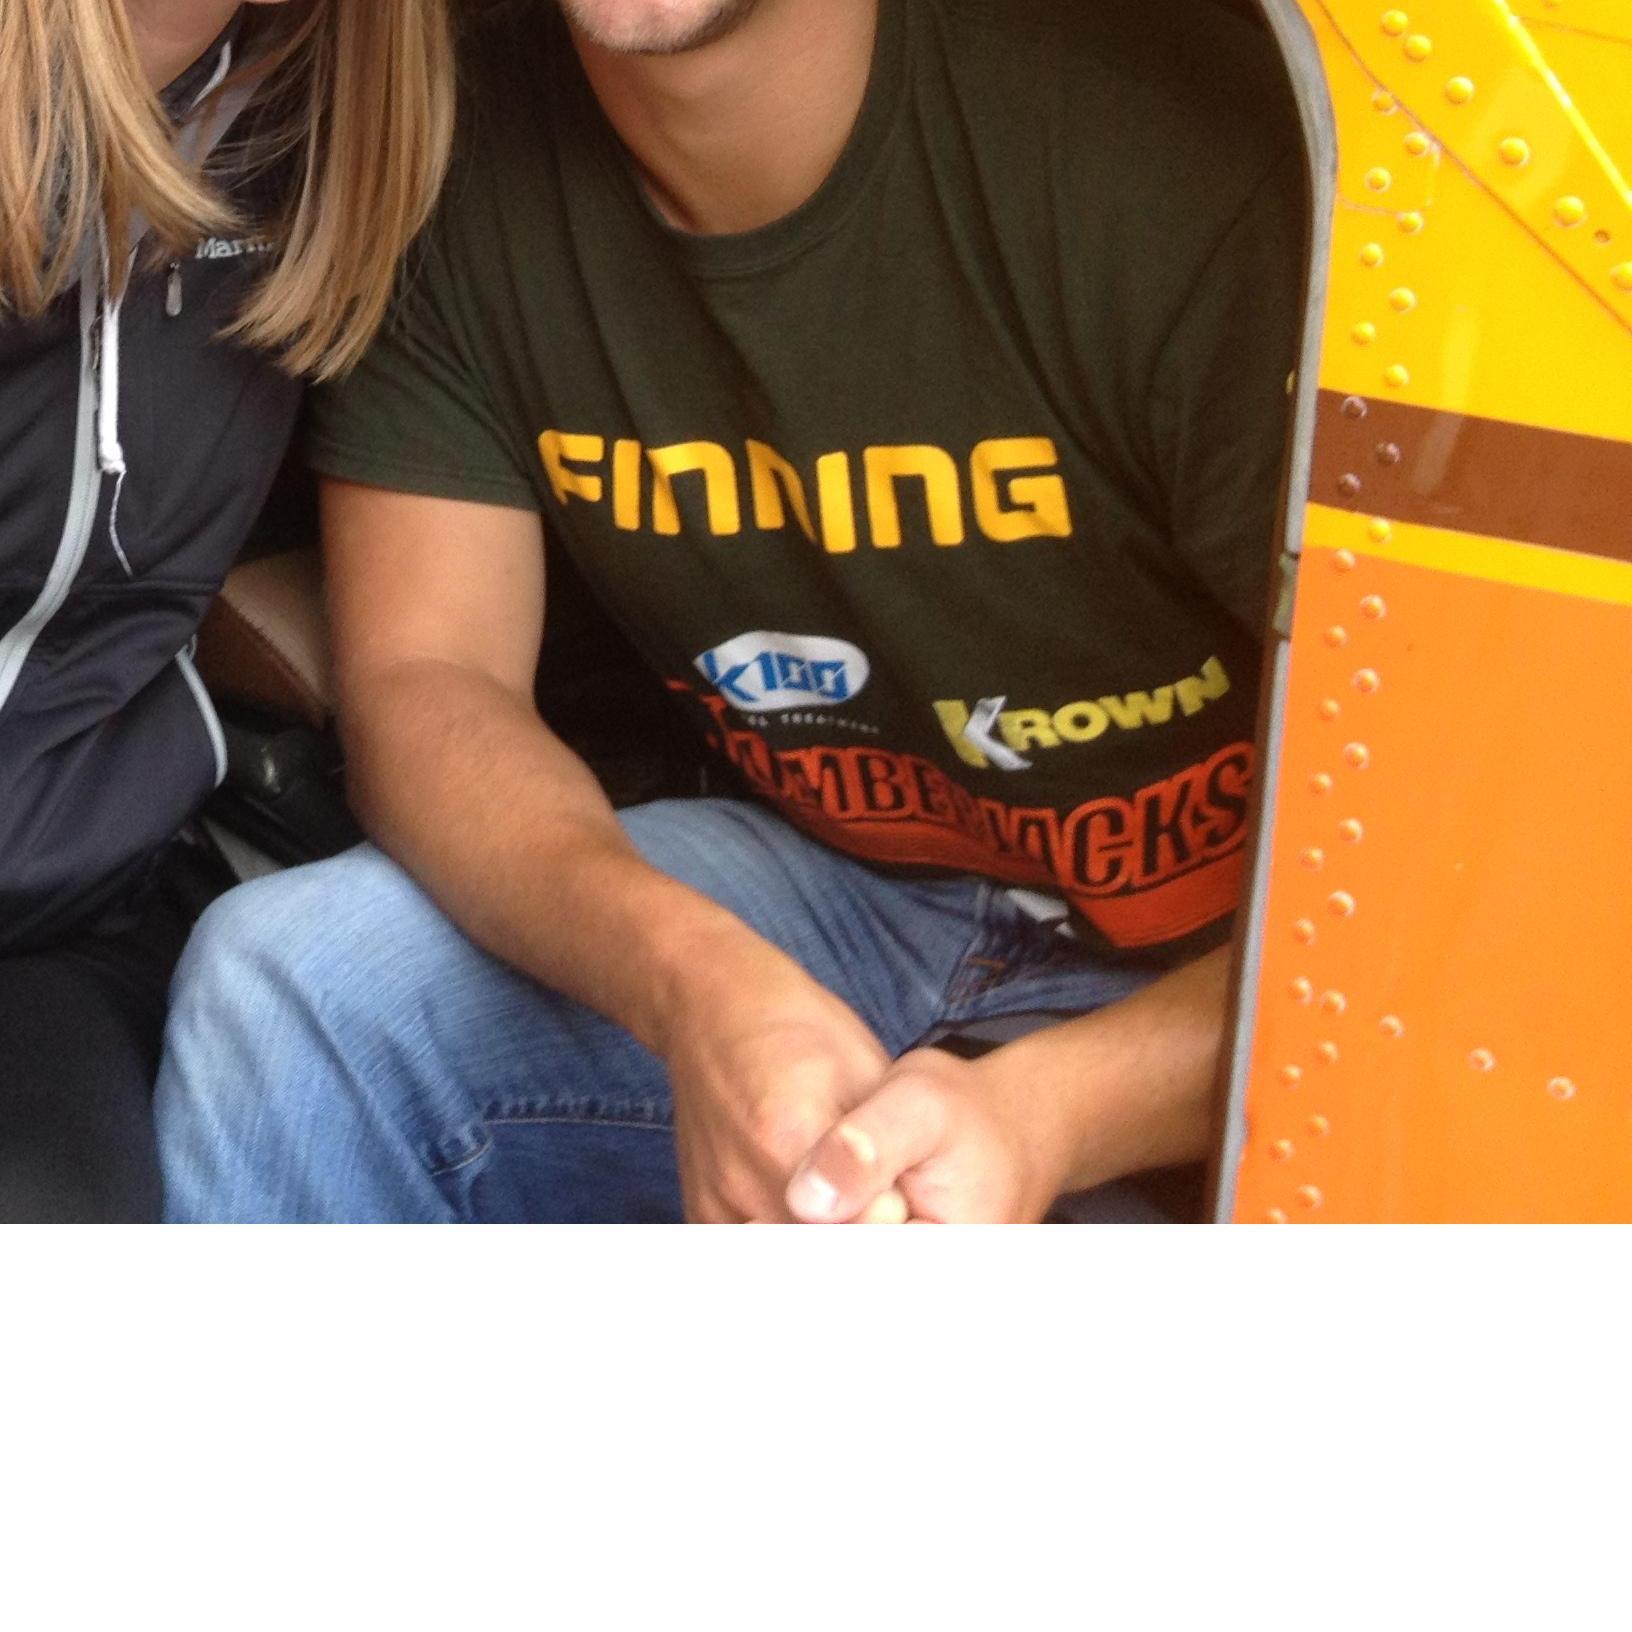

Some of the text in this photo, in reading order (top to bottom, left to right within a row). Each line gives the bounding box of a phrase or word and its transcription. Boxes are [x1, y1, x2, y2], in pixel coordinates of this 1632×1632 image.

[196, 237, 273, 259] Mar
[538, 430, 1072, 554] FINNING
[932, 655, 1231, 771] KROWN
